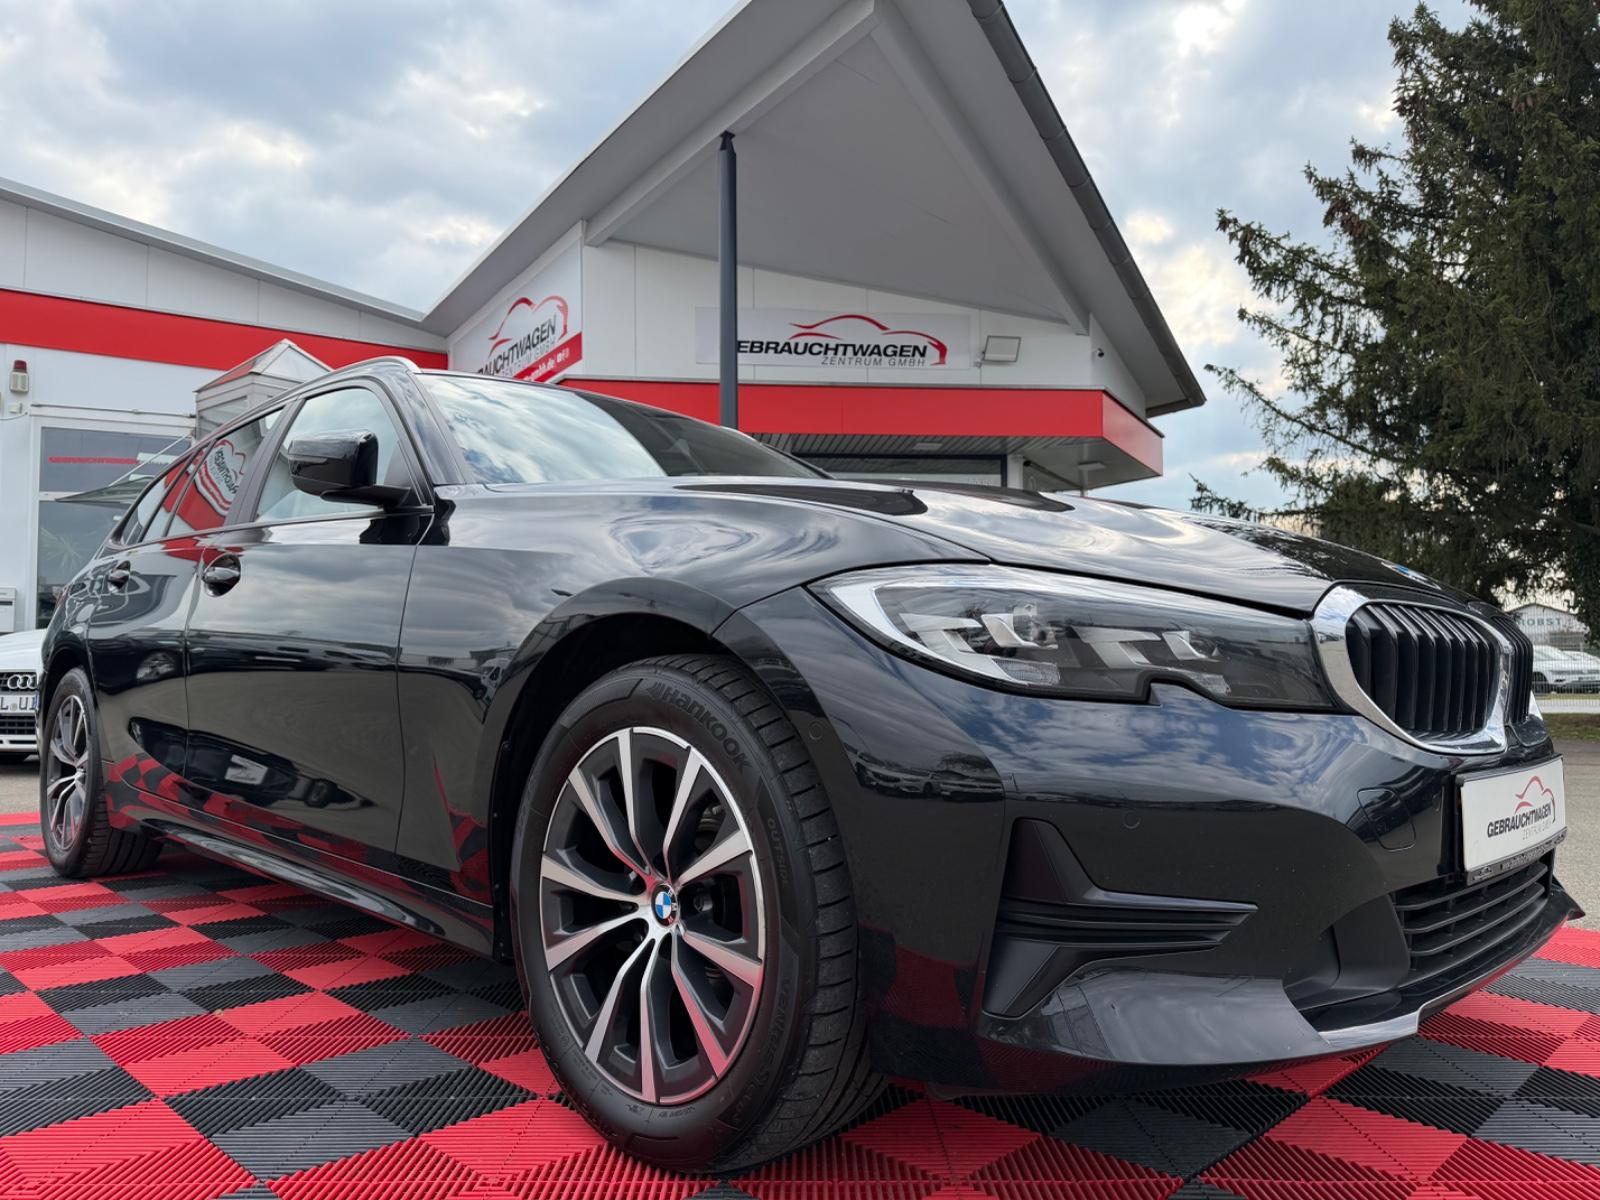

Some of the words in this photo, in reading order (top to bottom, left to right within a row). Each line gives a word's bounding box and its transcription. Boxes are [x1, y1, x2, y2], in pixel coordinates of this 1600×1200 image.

[477, 314, 556, 377] AUCHTWAGEN
[736, 340, 928, 358] EBRAUCHTWAGEN
[820, 356, 883, 367] ZENTRUM
[888, 357, 926, 367] GMBH
[1487, 802, 1552, 838] GEBRAUCHTWAGEN
